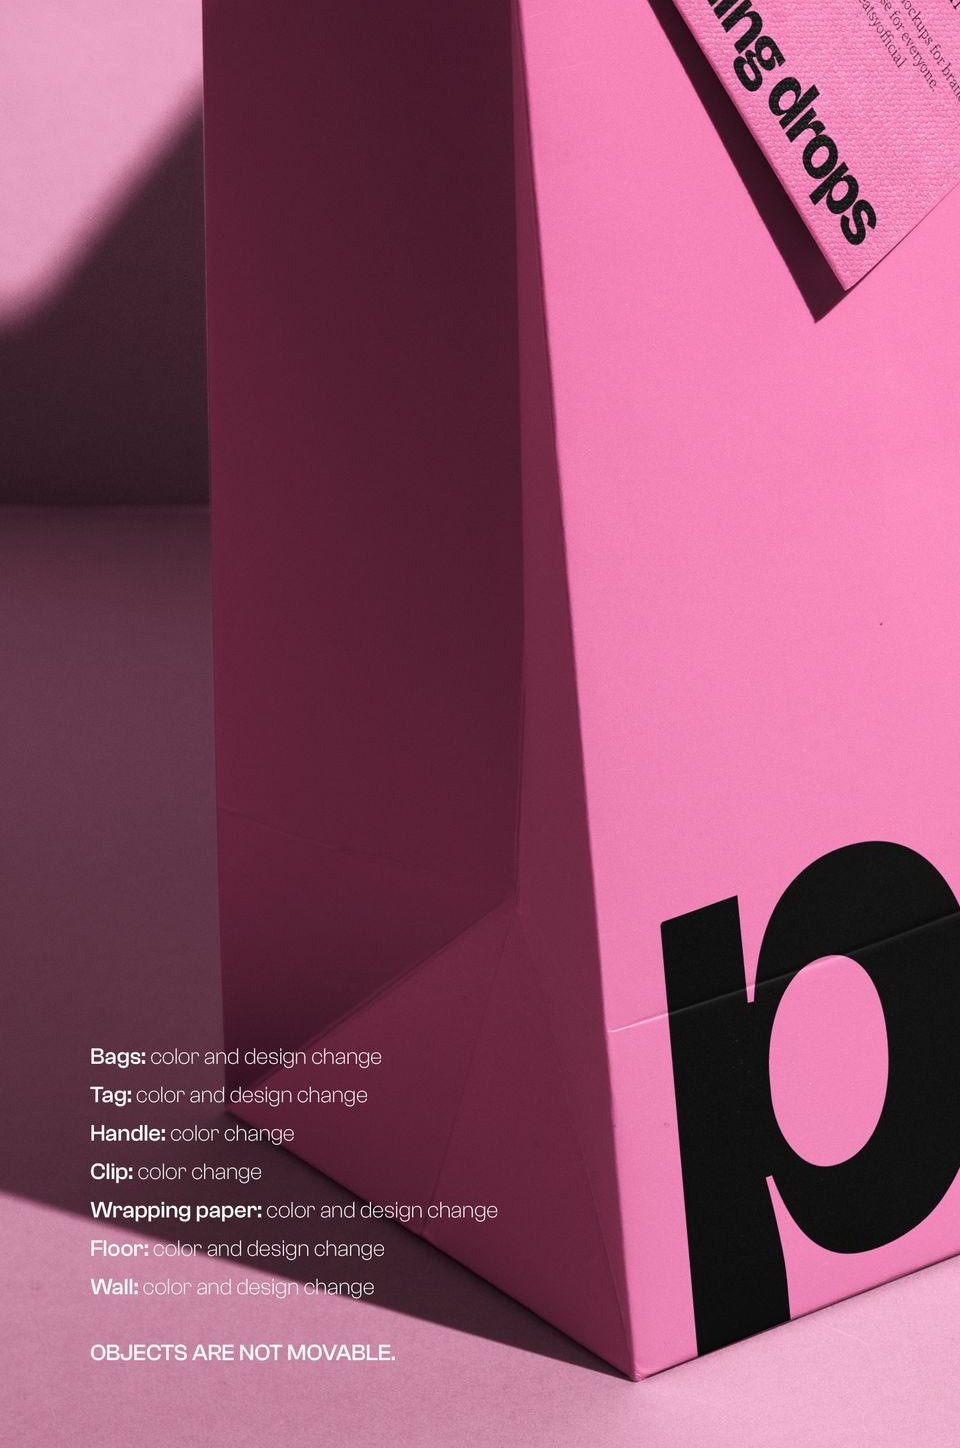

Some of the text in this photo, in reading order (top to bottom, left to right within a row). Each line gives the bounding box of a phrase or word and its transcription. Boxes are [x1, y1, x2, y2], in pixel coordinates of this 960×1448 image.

[889, 10, 904, 31] for
[901, 32, 938, 92] everyone.
[929, 44, 945, 65] for
[768, 76, 876, 246] drops
